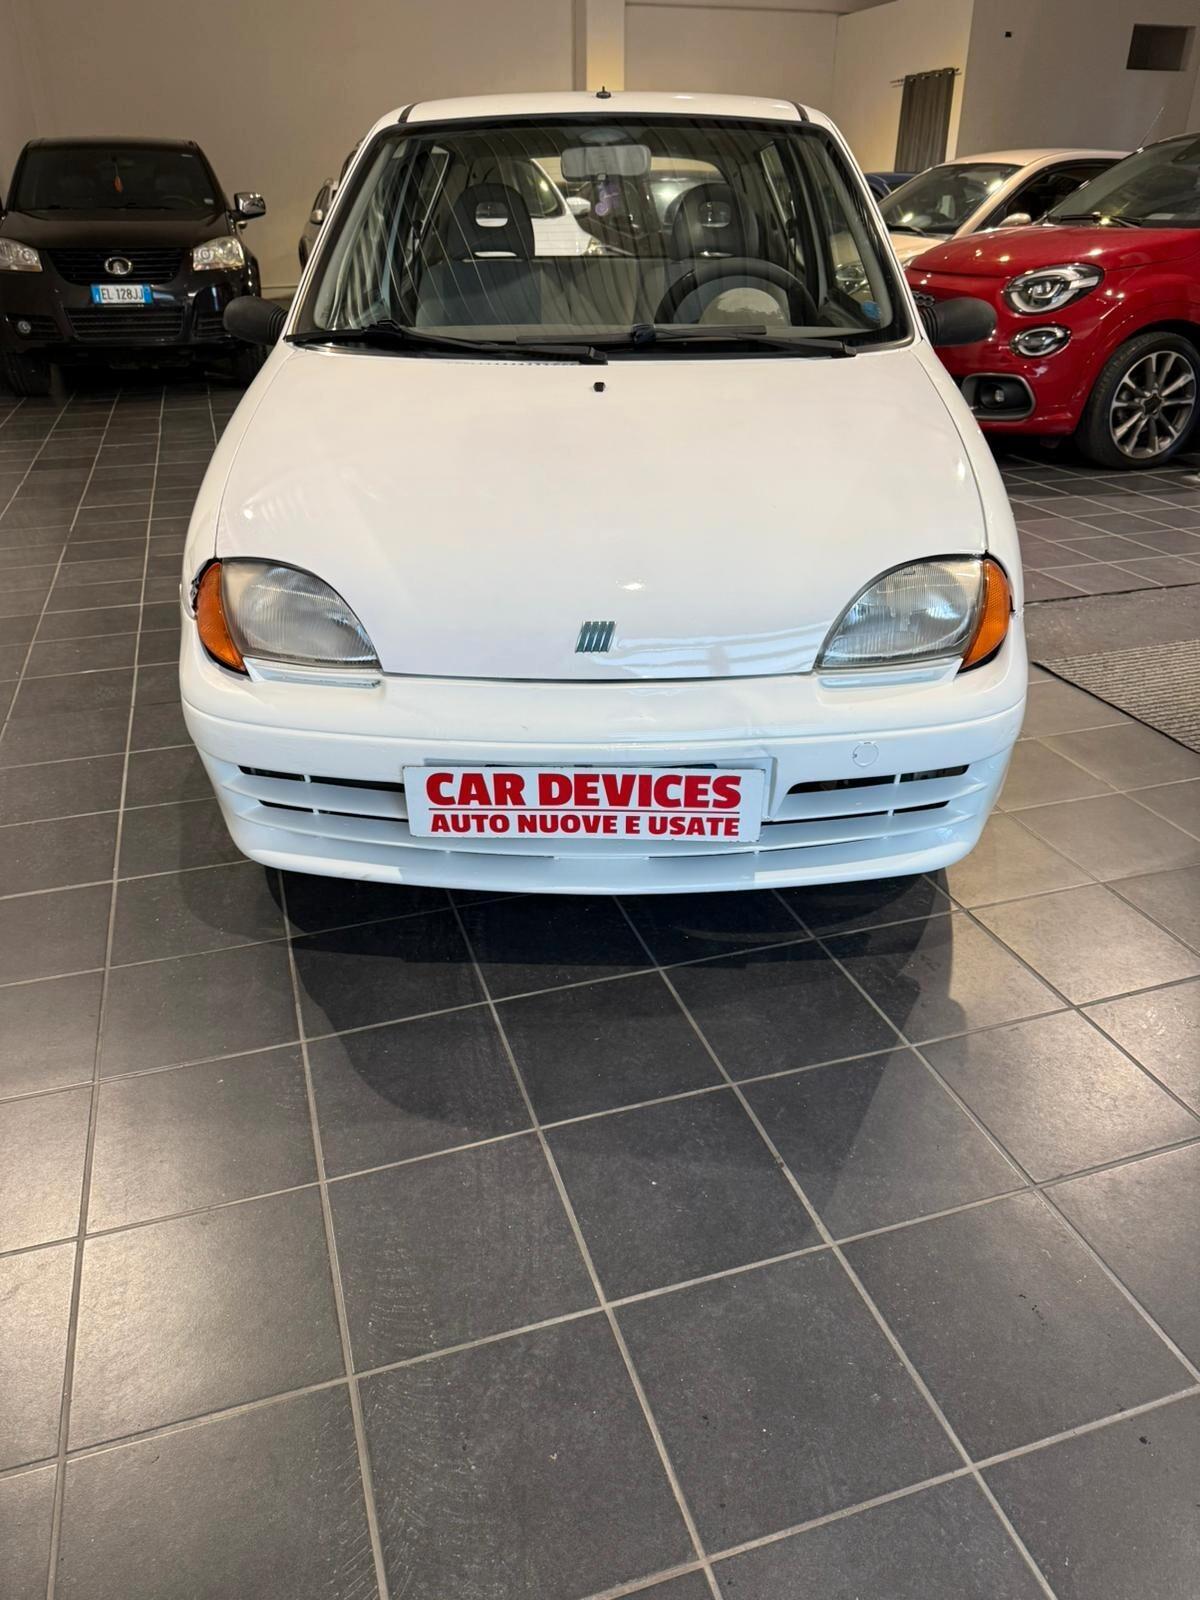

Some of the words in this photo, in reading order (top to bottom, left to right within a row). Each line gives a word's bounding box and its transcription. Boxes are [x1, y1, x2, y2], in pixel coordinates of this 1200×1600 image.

[101, 288, 113, 300] EL
[425, 772, 526, 807] CAR
[538, 773, 742, 808] DEVICES
[431, 813, 511, 833] AUTO
[518, 814, 618, 834] NUOVE
[625, 816, 640, 834] E
[648, 816, 740, 836] USATE
